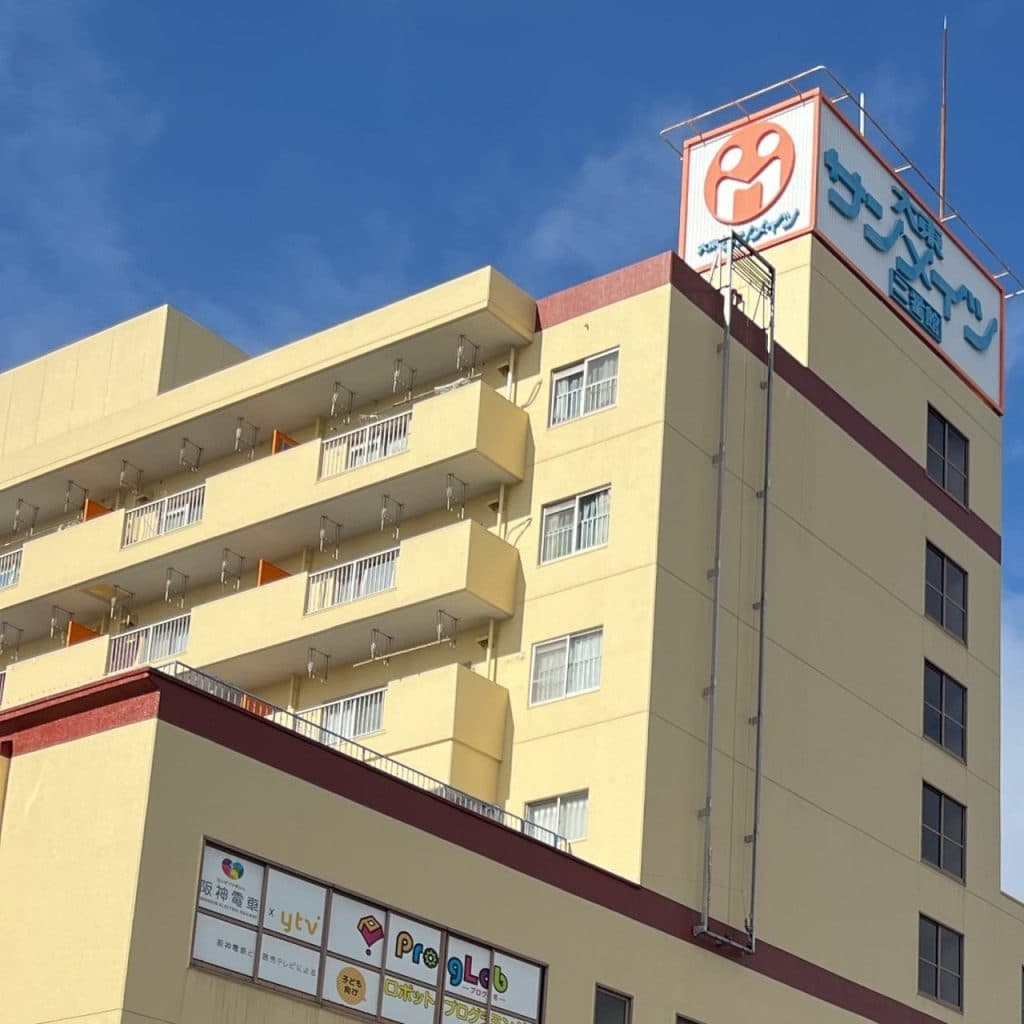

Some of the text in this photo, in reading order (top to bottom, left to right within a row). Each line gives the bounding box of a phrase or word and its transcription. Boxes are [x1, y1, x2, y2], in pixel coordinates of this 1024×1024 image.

[891, 184, 944, 261] 大東
[823, 147, 998, 353] サンメイツ
[281, 911, 318, 936] ytv
[384, 978, 436, 1010] ロボット
